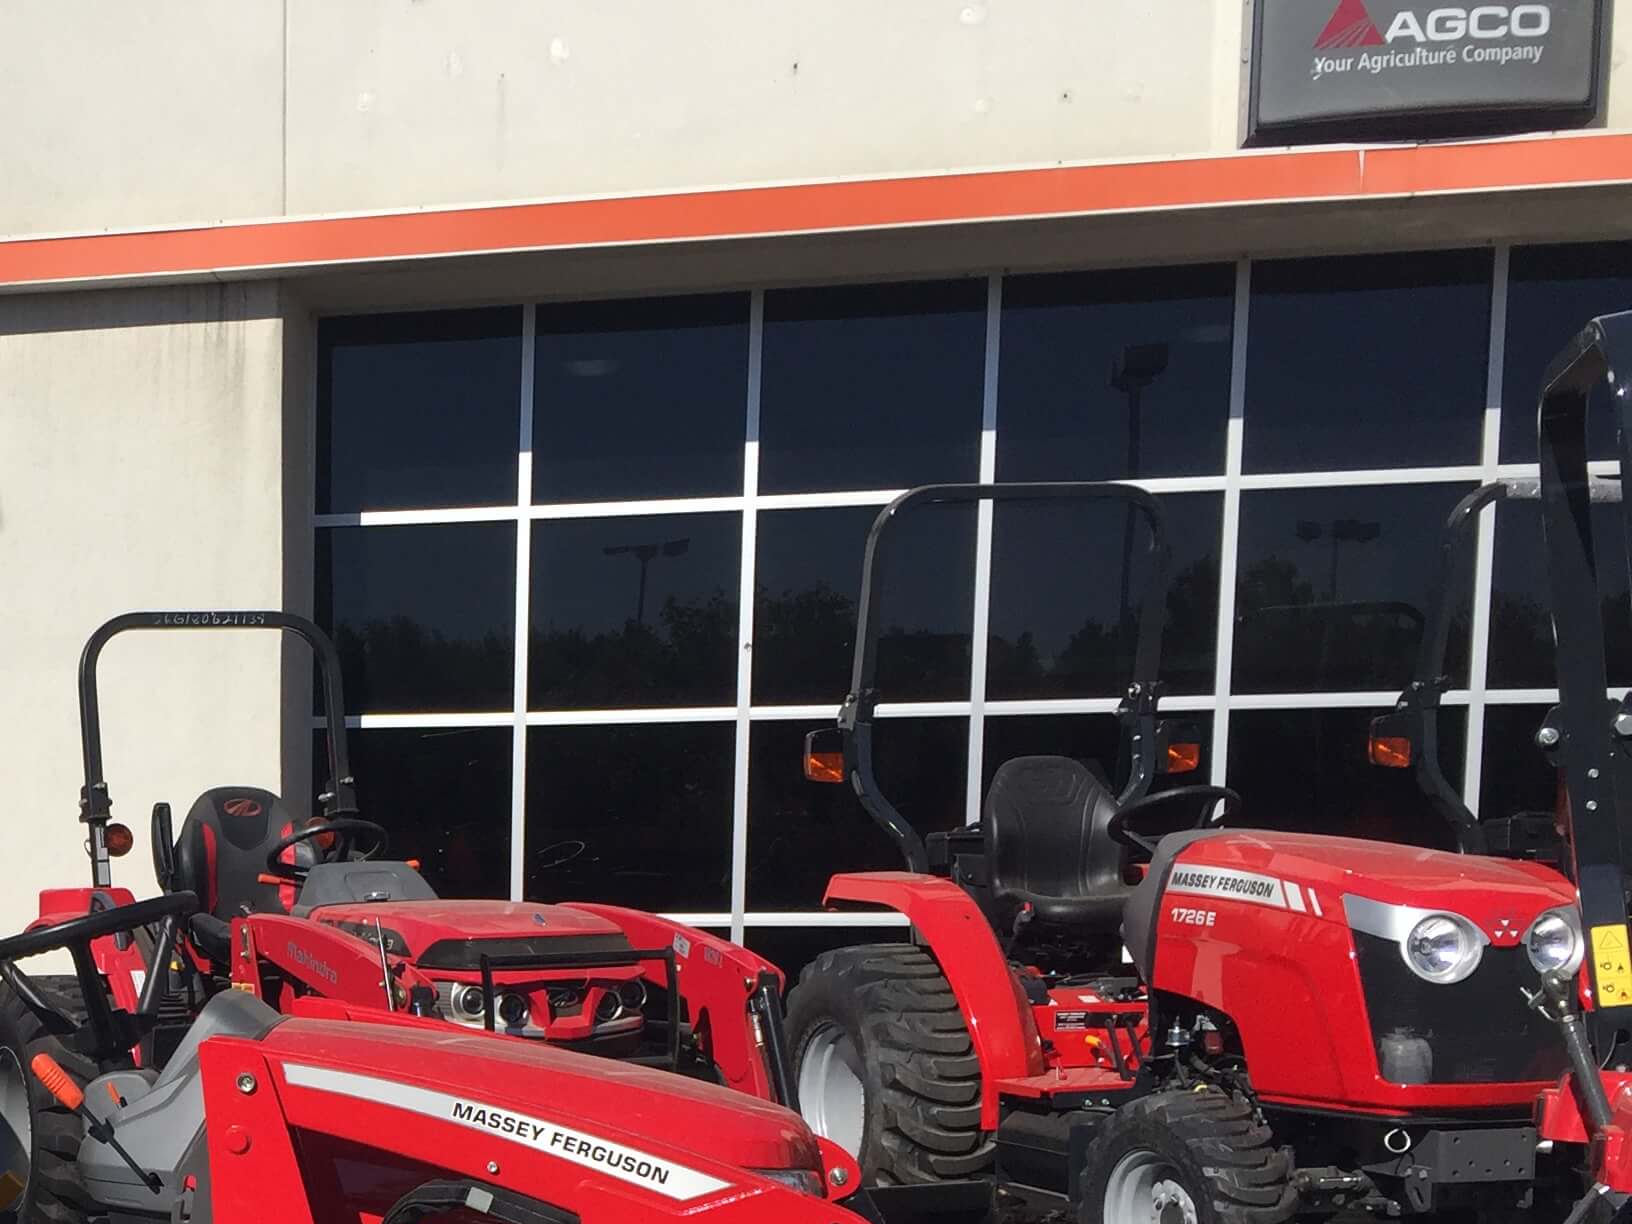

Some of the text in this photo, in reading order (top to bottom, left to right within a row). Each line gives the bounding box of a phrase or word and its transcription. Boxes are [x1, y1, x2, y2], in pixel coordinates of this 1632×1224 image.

[1385, 5, 1551, 43] AGCO
[1313, 45, 1544, 73] Your Agriculture Company
[1171, 872, 1275, 898] MASSEY FERGUSON
[451, 1102, 670, 1185] MASSEY FERGUSON
